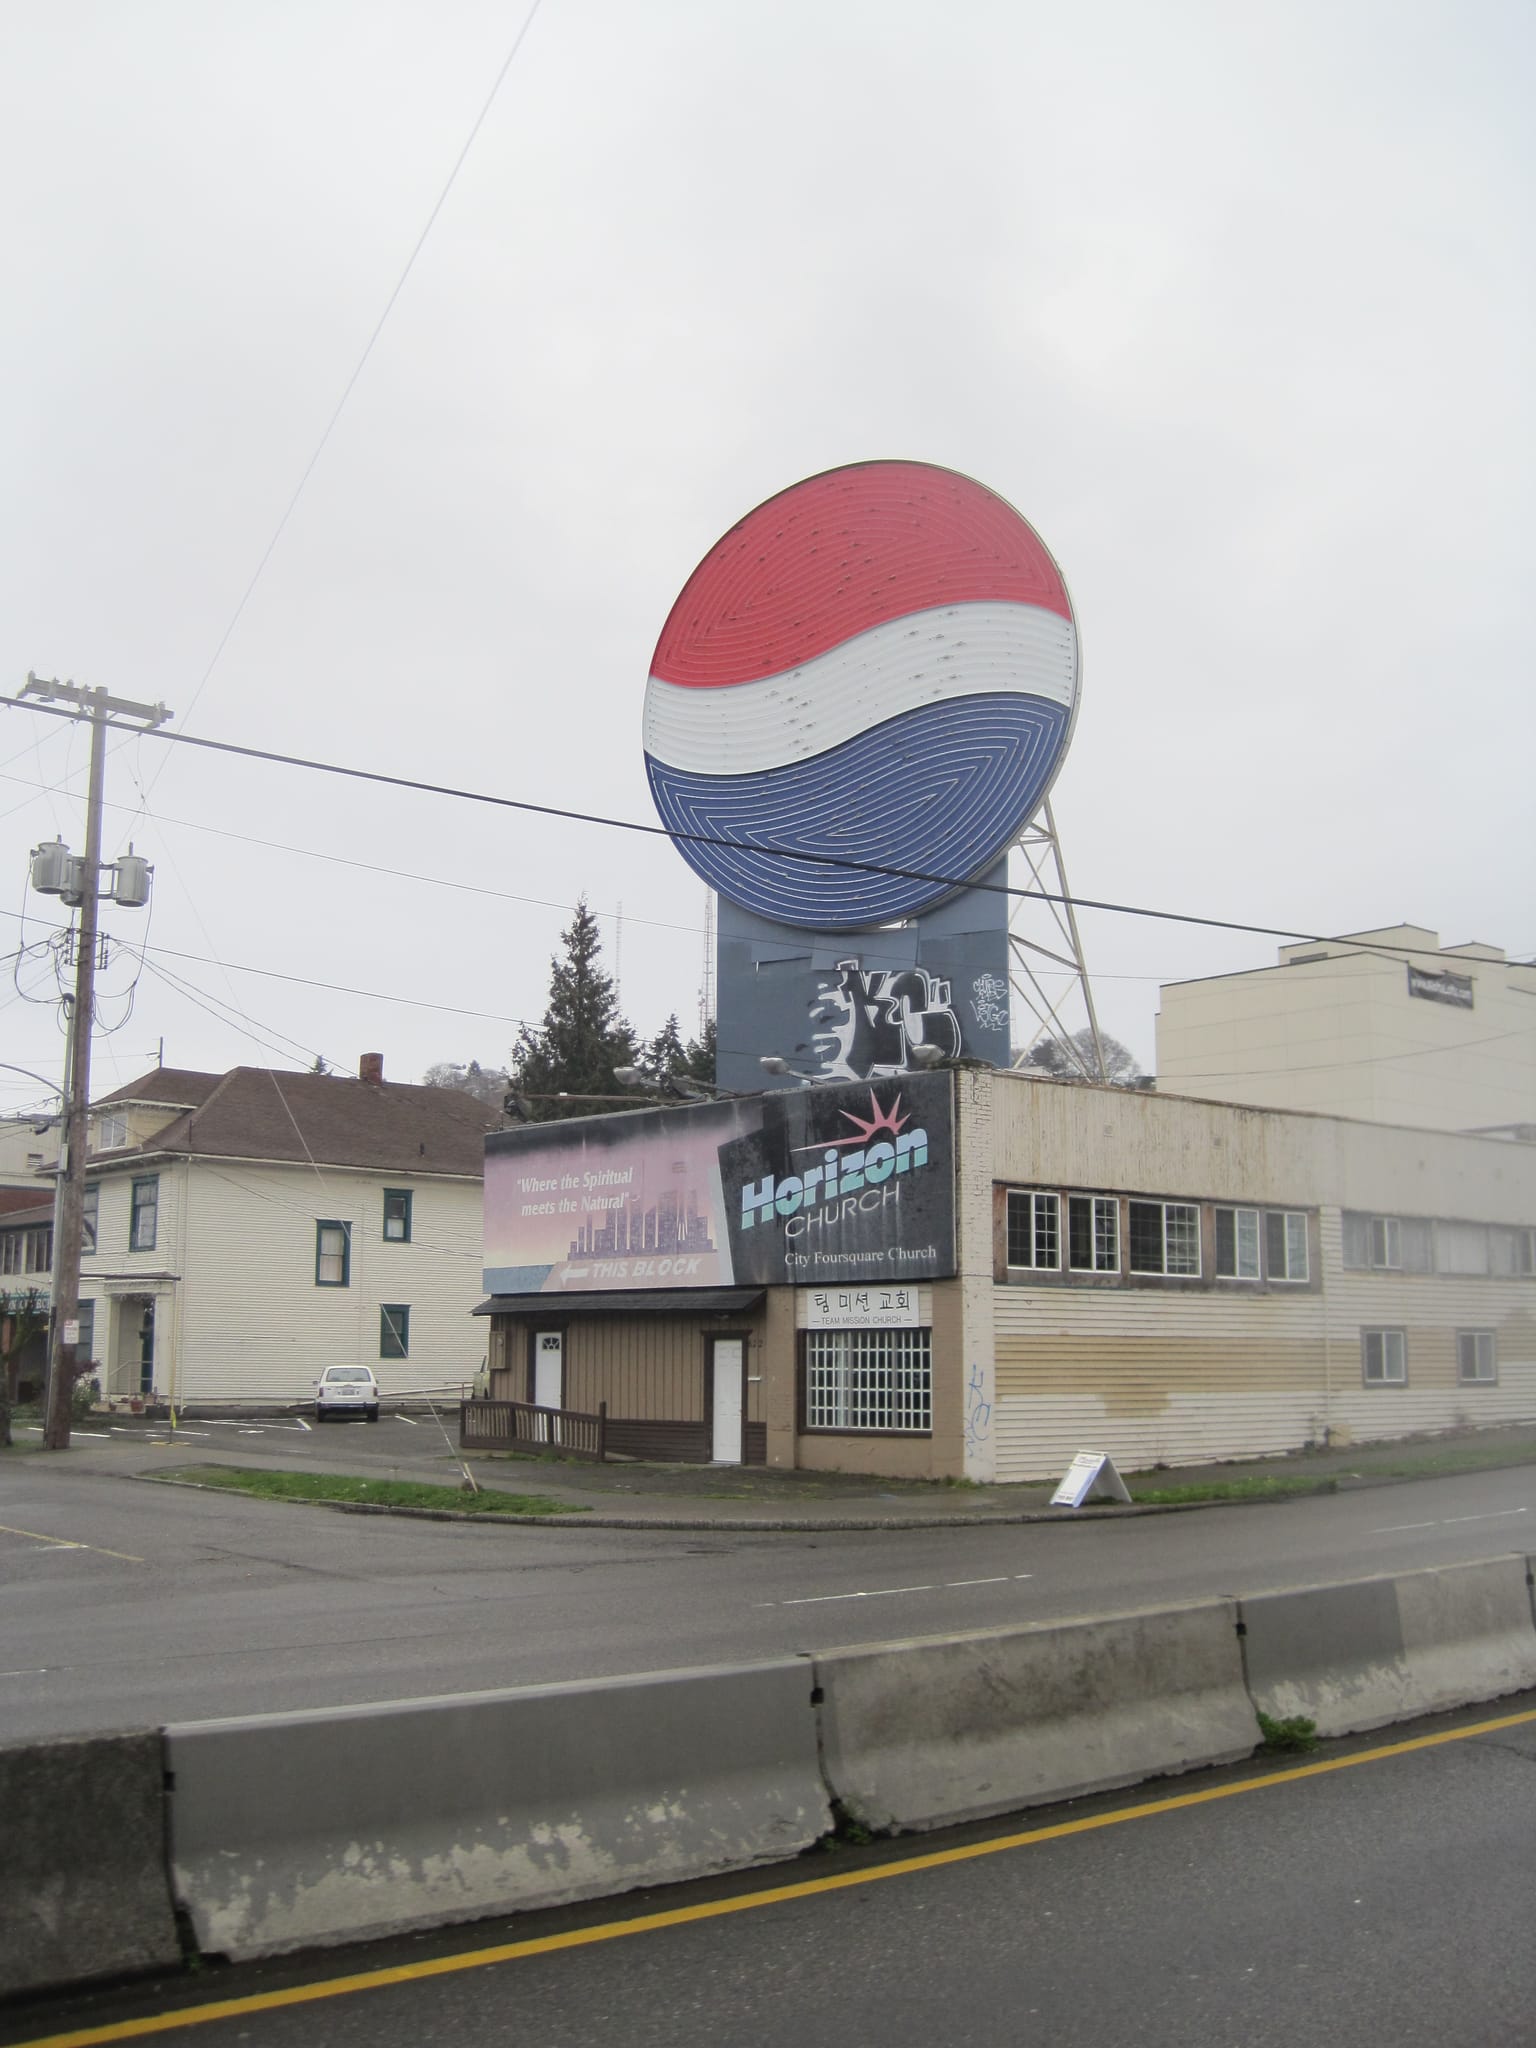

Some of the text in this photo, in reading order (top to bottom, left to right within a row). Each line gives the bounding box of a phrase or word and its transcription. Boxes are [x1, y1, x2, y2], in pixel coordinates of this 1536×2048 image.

[561, 1173, 580, 1191] the
[583, 1167, 633, 1192] Spiritual
[741, 1127, 929, 1231] Horizon
[521, 1202, 557, 1217] meets
[558, 1198, 578, 1213] the
[784, 1180, 900, 1239] CHURCH
[784, 1245, 937, 1268] City Foursquare Church
[592, 1259, 702, 1279] THIS BLOCK
[814, 1289, 910, 1313] 팀 미션 교회
[822, 1315, 901, 1325] TEAM MISSION CHURCH
